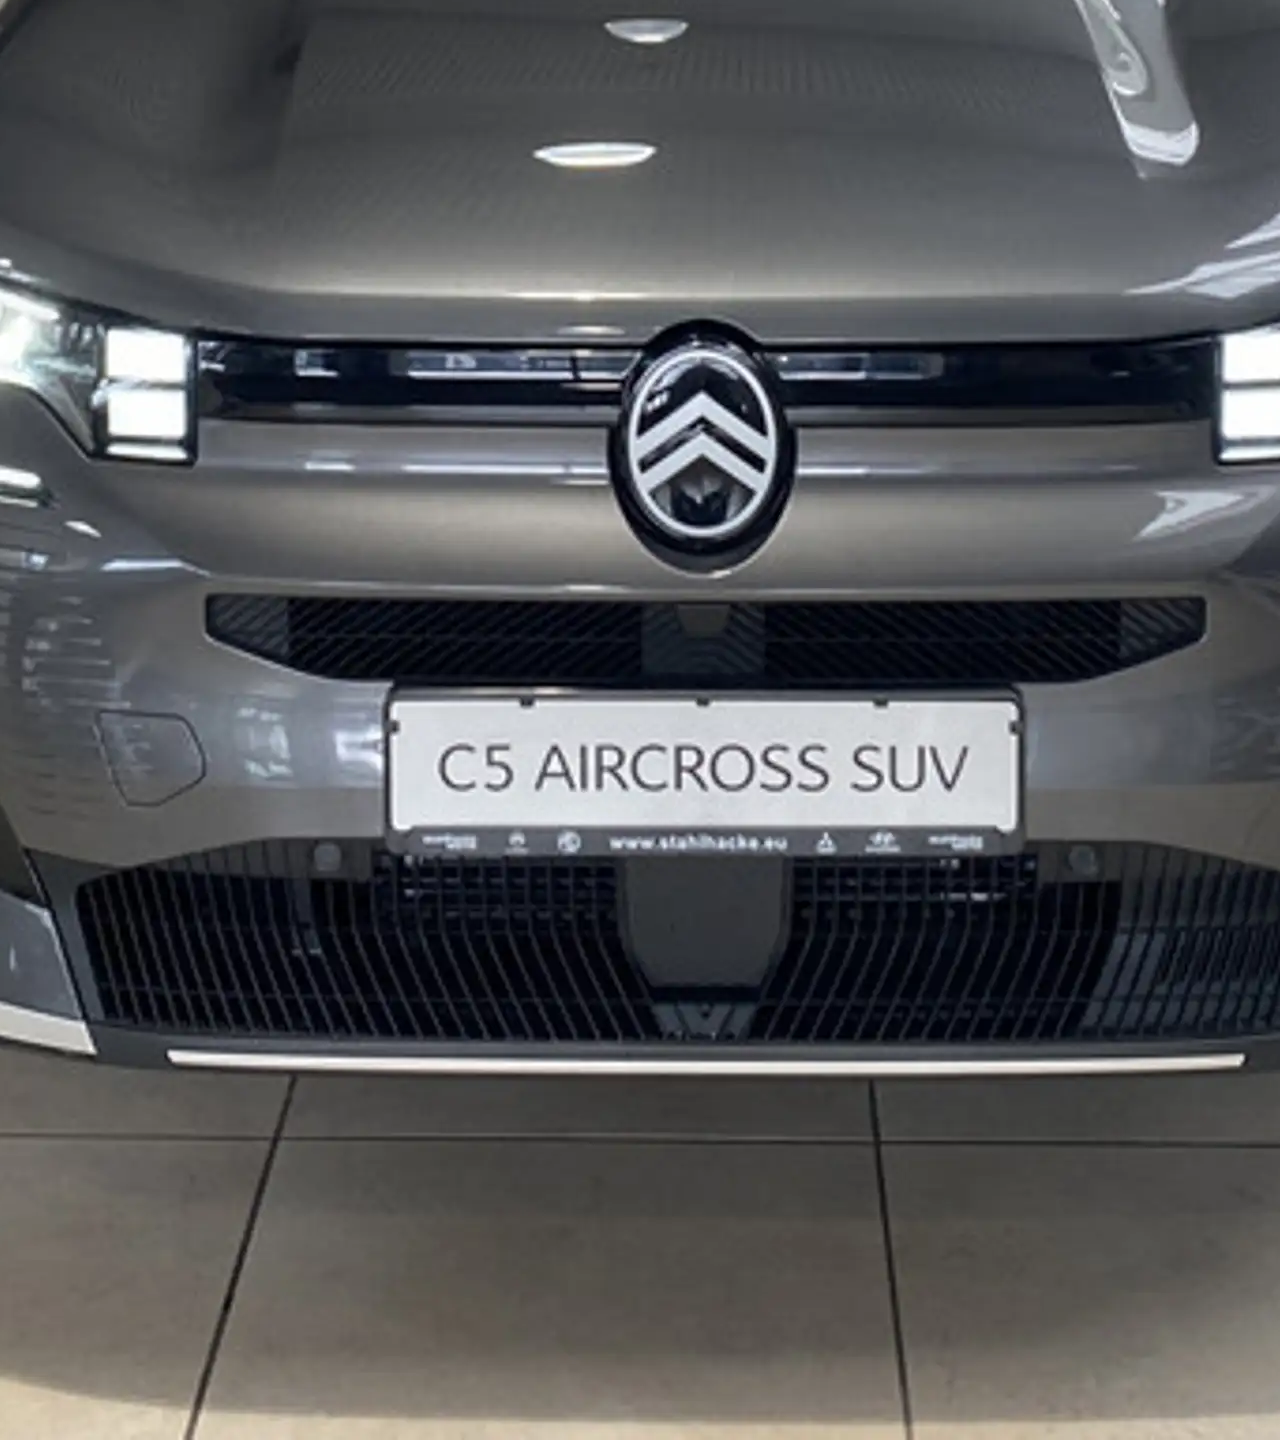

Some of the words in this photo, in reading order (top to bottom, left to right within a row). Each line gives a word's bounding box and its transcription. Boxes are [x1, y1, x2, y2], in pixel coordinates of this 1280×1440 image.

[438, 744, 512, 793] C5
[535, 744, 830, 793] AIRCROSS
[851, 744, 970, 793] SUV
